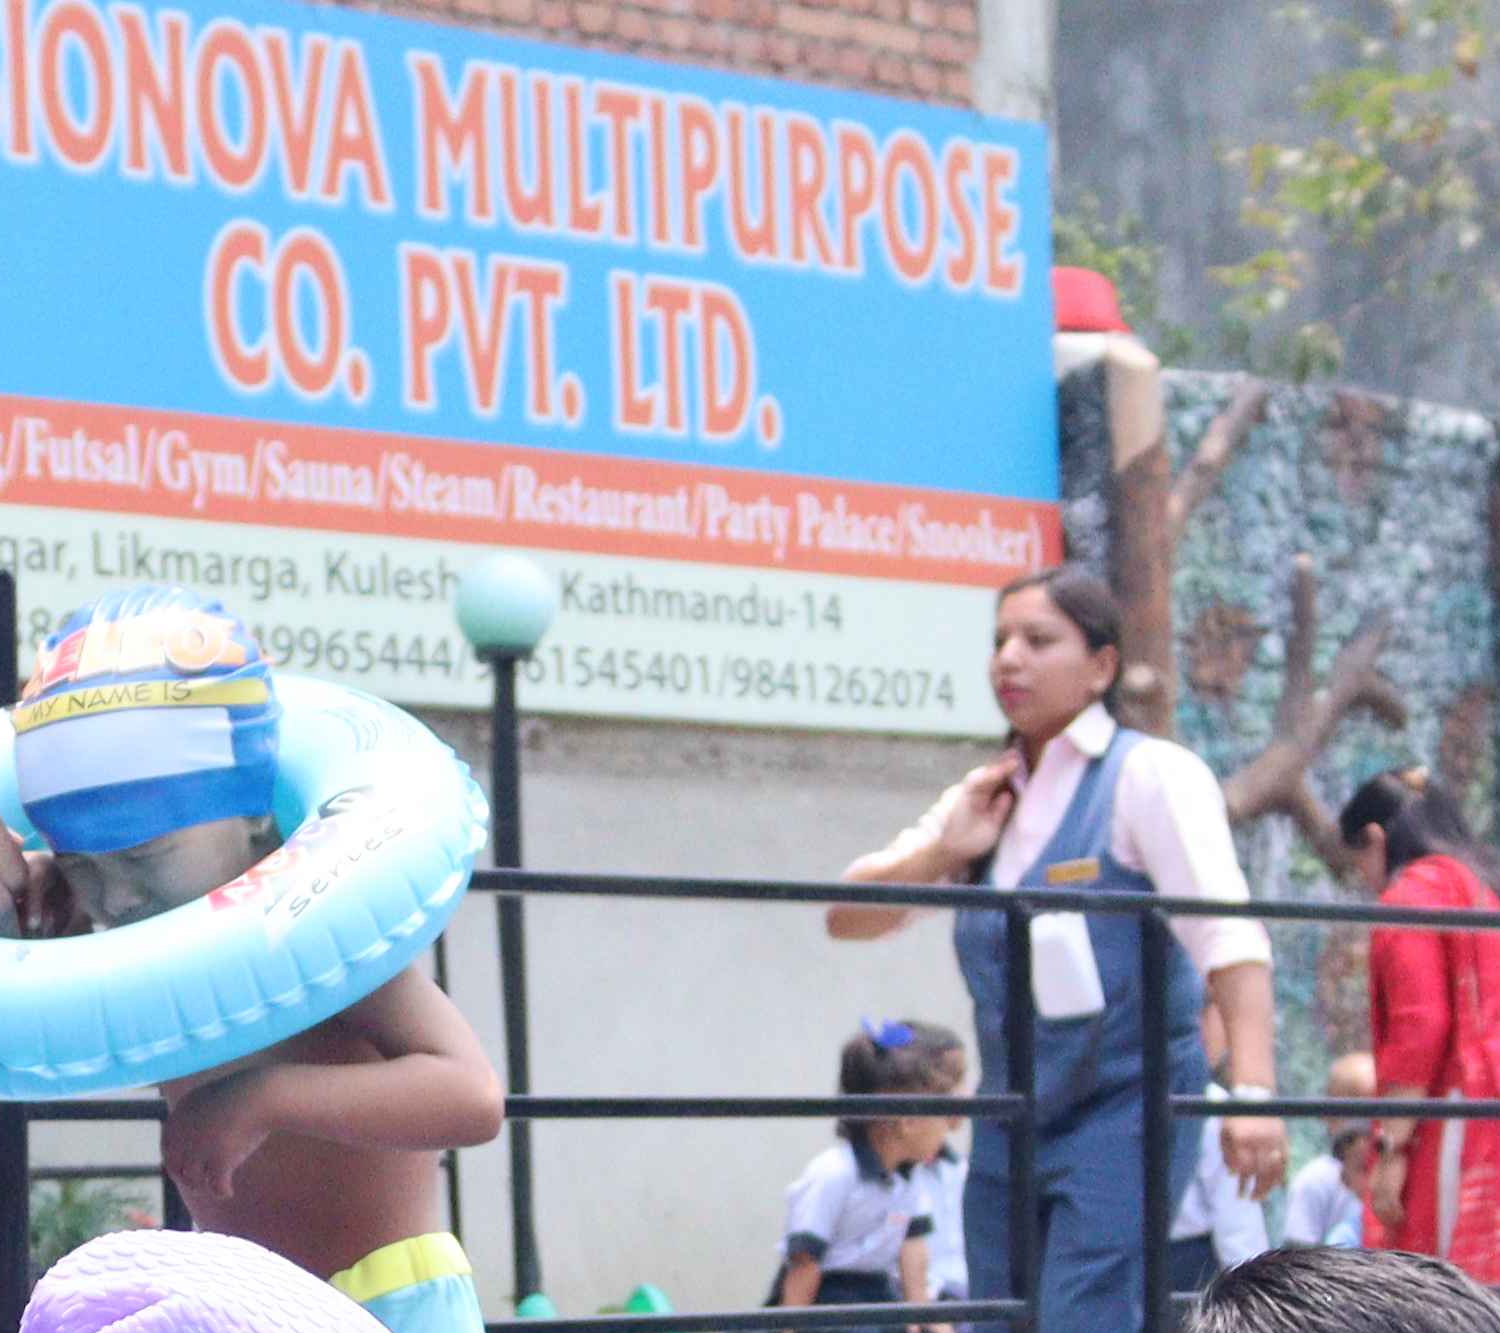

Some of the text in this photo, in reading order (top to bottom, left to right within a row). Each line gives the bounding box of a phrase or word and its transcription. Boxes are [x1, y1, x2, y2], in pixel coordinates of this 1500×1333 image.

[410, 54, 1021, 294] MULTIPURPOSE
[209, 224, 780, 443] CO. PVT. LTD.
[92, 530, 312, 601] Likmarga,
[558, 565, 844, 632] Kathmandu-14
[67, 683, 150, 713] NAME
[162, 679, 192, 702] IS
